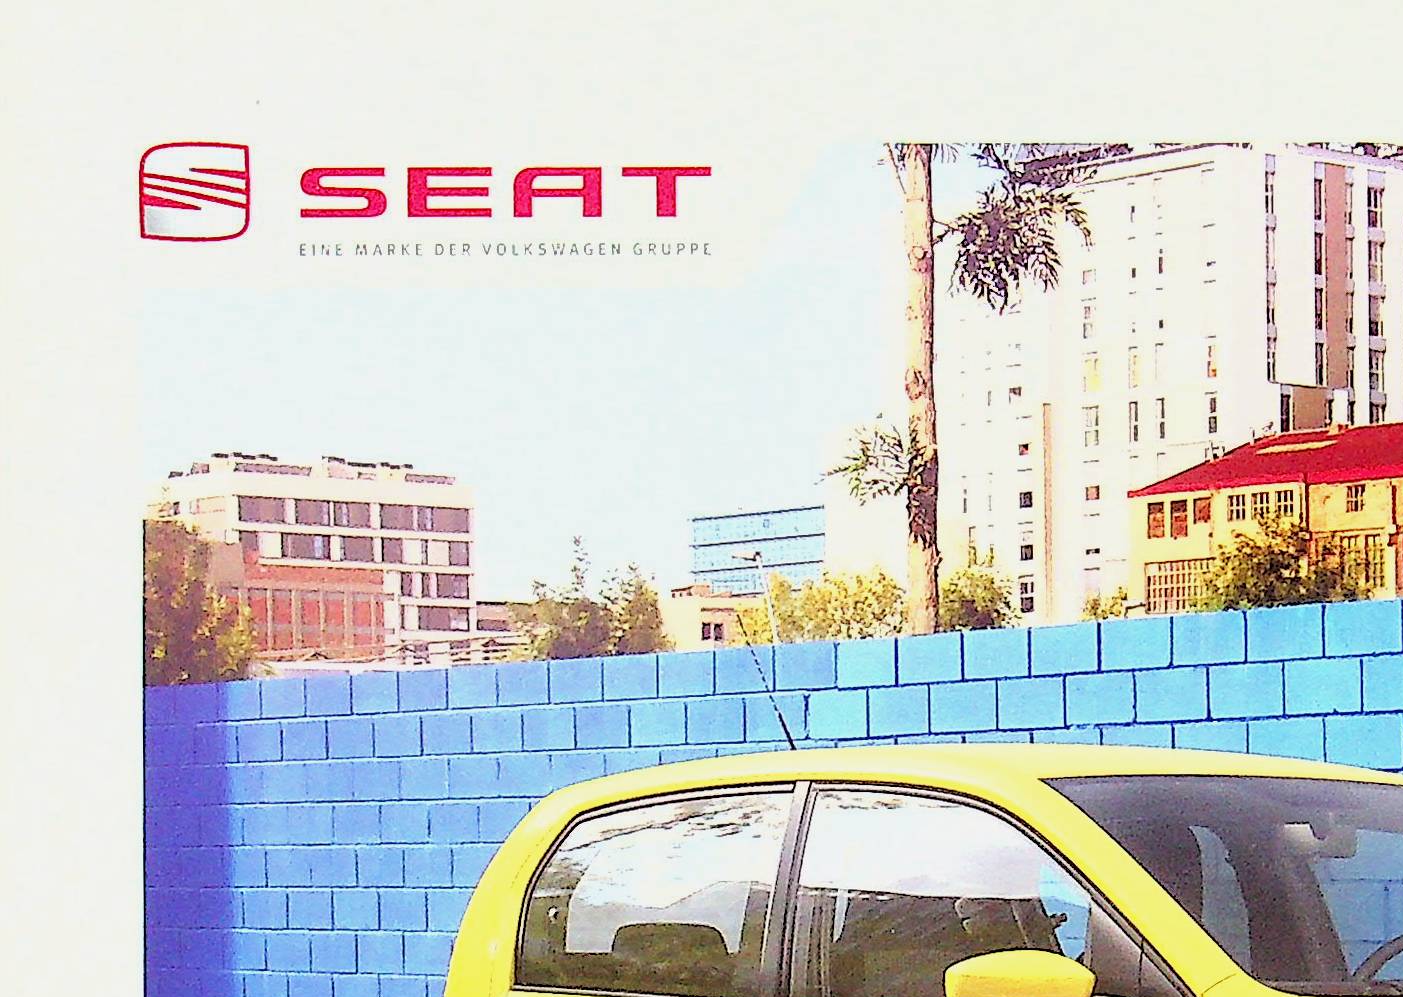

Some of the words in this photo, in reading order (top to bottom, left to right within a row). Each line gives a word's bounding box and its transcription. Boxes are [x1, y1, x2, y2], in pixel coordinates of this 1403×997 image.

[300, 166, 712, 218] SEAT
[299, 243, 343, 256] EINE
[355, 243, 423, 256] MARKE
[434, 243, 472, 256] DER
[482, 242, 621, 256] VOLKSWAGEN
[633, 242, 712, 256] GRUPPE
